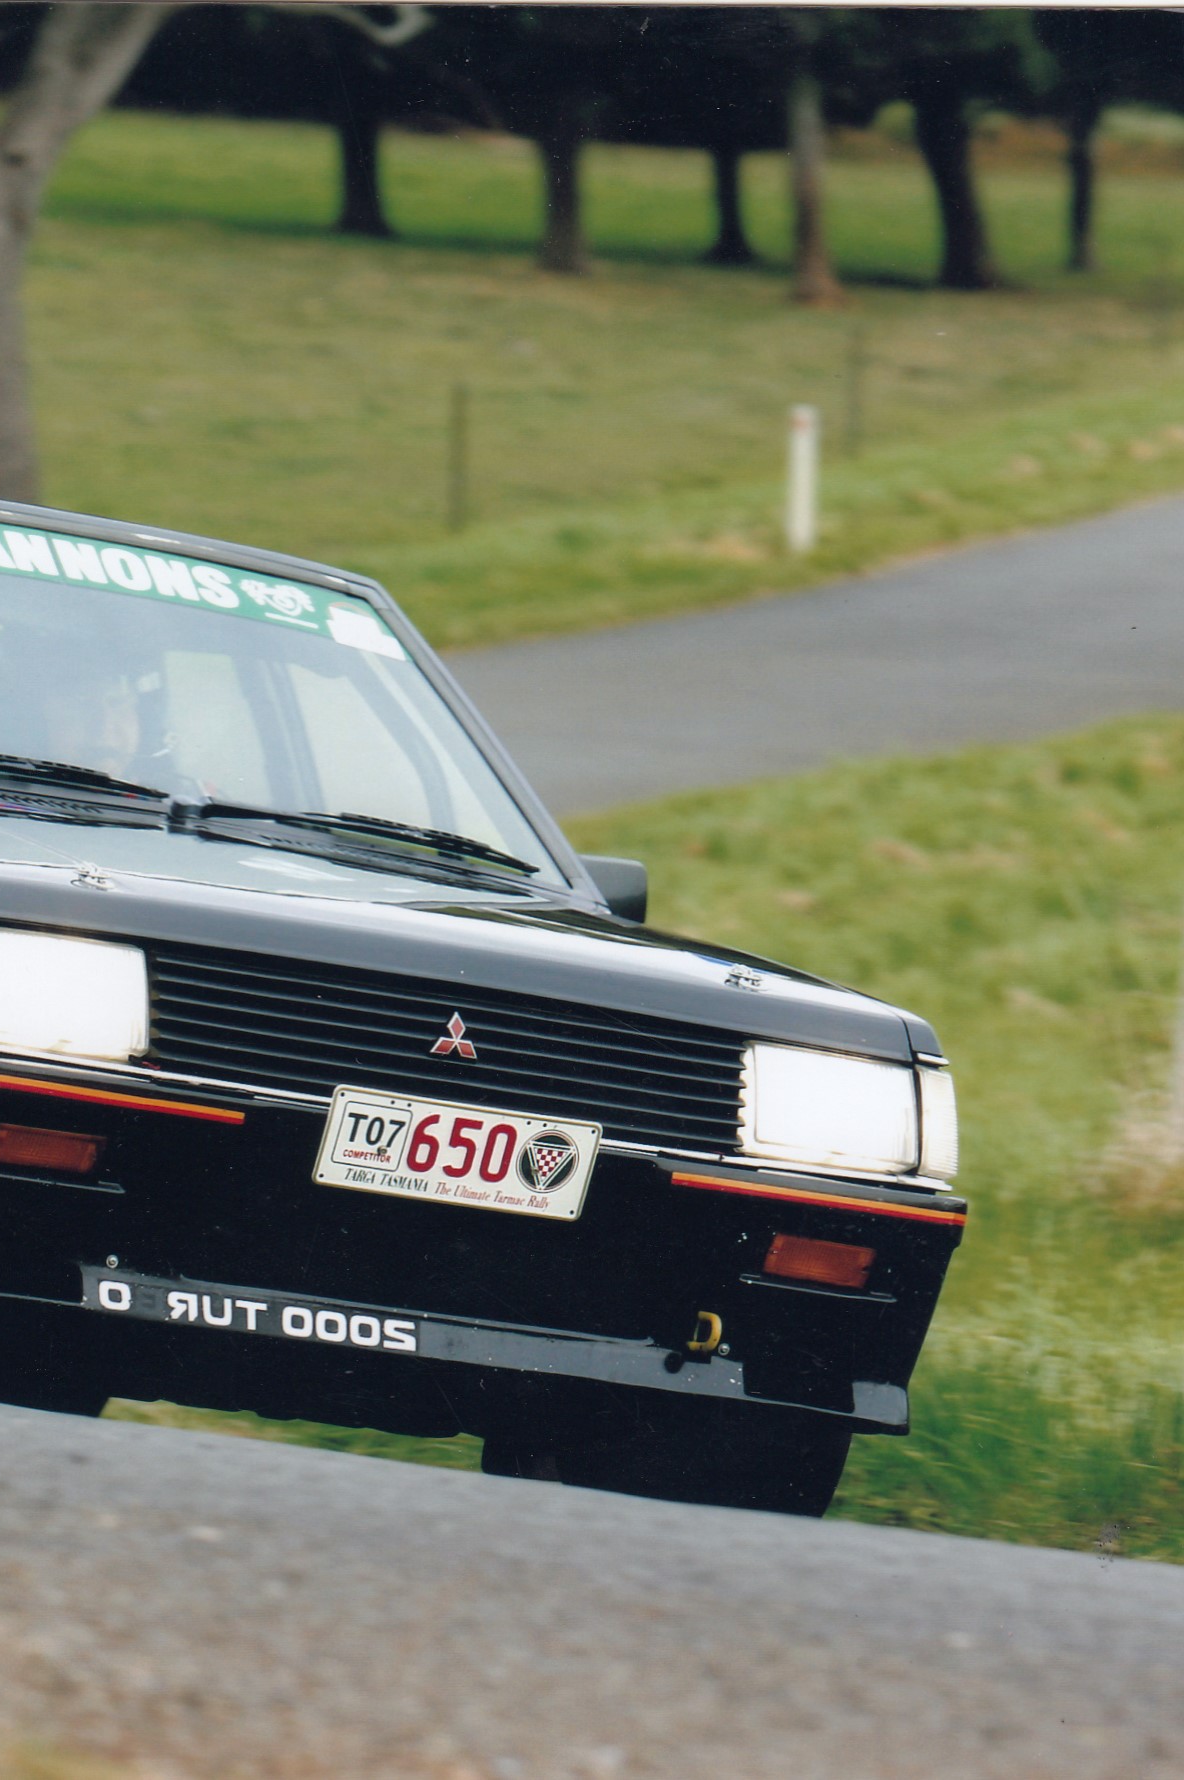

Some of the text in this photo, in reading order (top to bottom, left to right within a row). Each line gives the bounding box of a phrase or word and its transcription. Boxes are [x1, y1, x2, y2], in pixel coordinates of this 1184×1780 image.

[348, 1112, 406, 1149] T07
[406, 1114, 518, 1182] 650
[342, 1149, 392, 1164] COMPETITOR
[344, 1168, 550, 1210] TARGA TASMANIA The Ultimate Tarmac Rally
